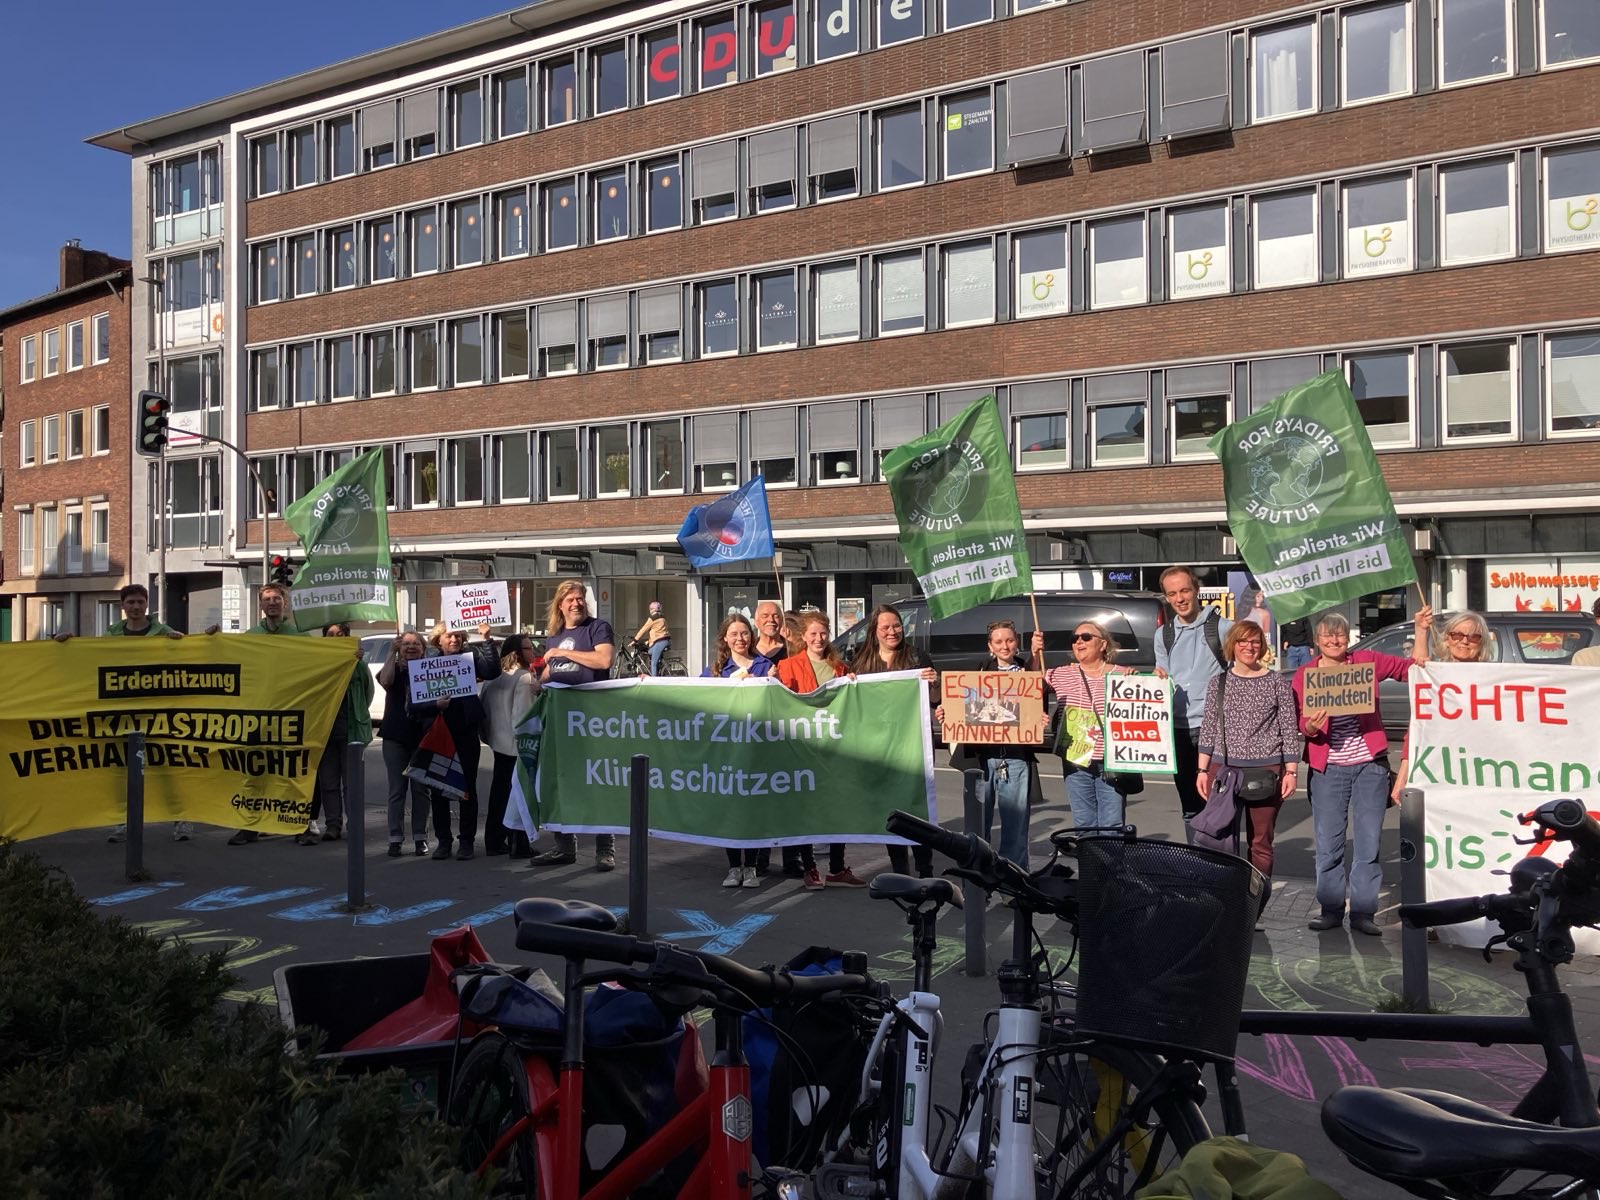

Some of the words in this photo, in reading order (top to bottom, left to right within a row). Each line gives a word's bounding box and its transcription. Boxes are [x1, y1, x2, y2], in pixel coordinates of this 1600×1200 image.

[455, 598, 497, 608] Koalition
[461, 589, 488, 598] Keine
[450, 616, 506, 629] Klimaschutz
[462, 606, 491, 619] ohne
[413, 669, 454, 682] schutz
[457, 666, 472, 675] ist
[420, 659, 461, 670] #Klima-
[105, 669, 235, 693] Erderhitzung
[429, 677, 455, 689] DAS
[945, 674, 972, 699] ES
[977, 673, 1009, 699] IST
[1003, 674, 1043, 700] 2025
[1305, 667, 1374, 689] Klimaziele
[416, 685, 472, 700] Fundament
[1110, 679, 1164, 700] Keine
[1305, 689, 1372, 708] einhalten!
[1106, 702, 1169, 722] Koalition
[1414, 683, 1568, 725] ECHTE
[28, 717, 86, 741] DIE
[93, 712, 299, 743] KATASTROPHE
[567, 710, 650, 738] Recht
[657, 711, 705, 742] auf
[710, 709, 843, 744] Zukunft
[943, 723, 1015, 743] MÄNNER
[1112, 722, 1158, 740] ohne
[218, 748, 310, 778] NICHT!
[1114, 745, 1168, 762] Klima
[1408, 745, 1600, 793] Kliman
[670, 764, 816, 796] schützen
[231, 794, 313, 815] GREENPEACE
[277, 814, 312, 825] Münster
